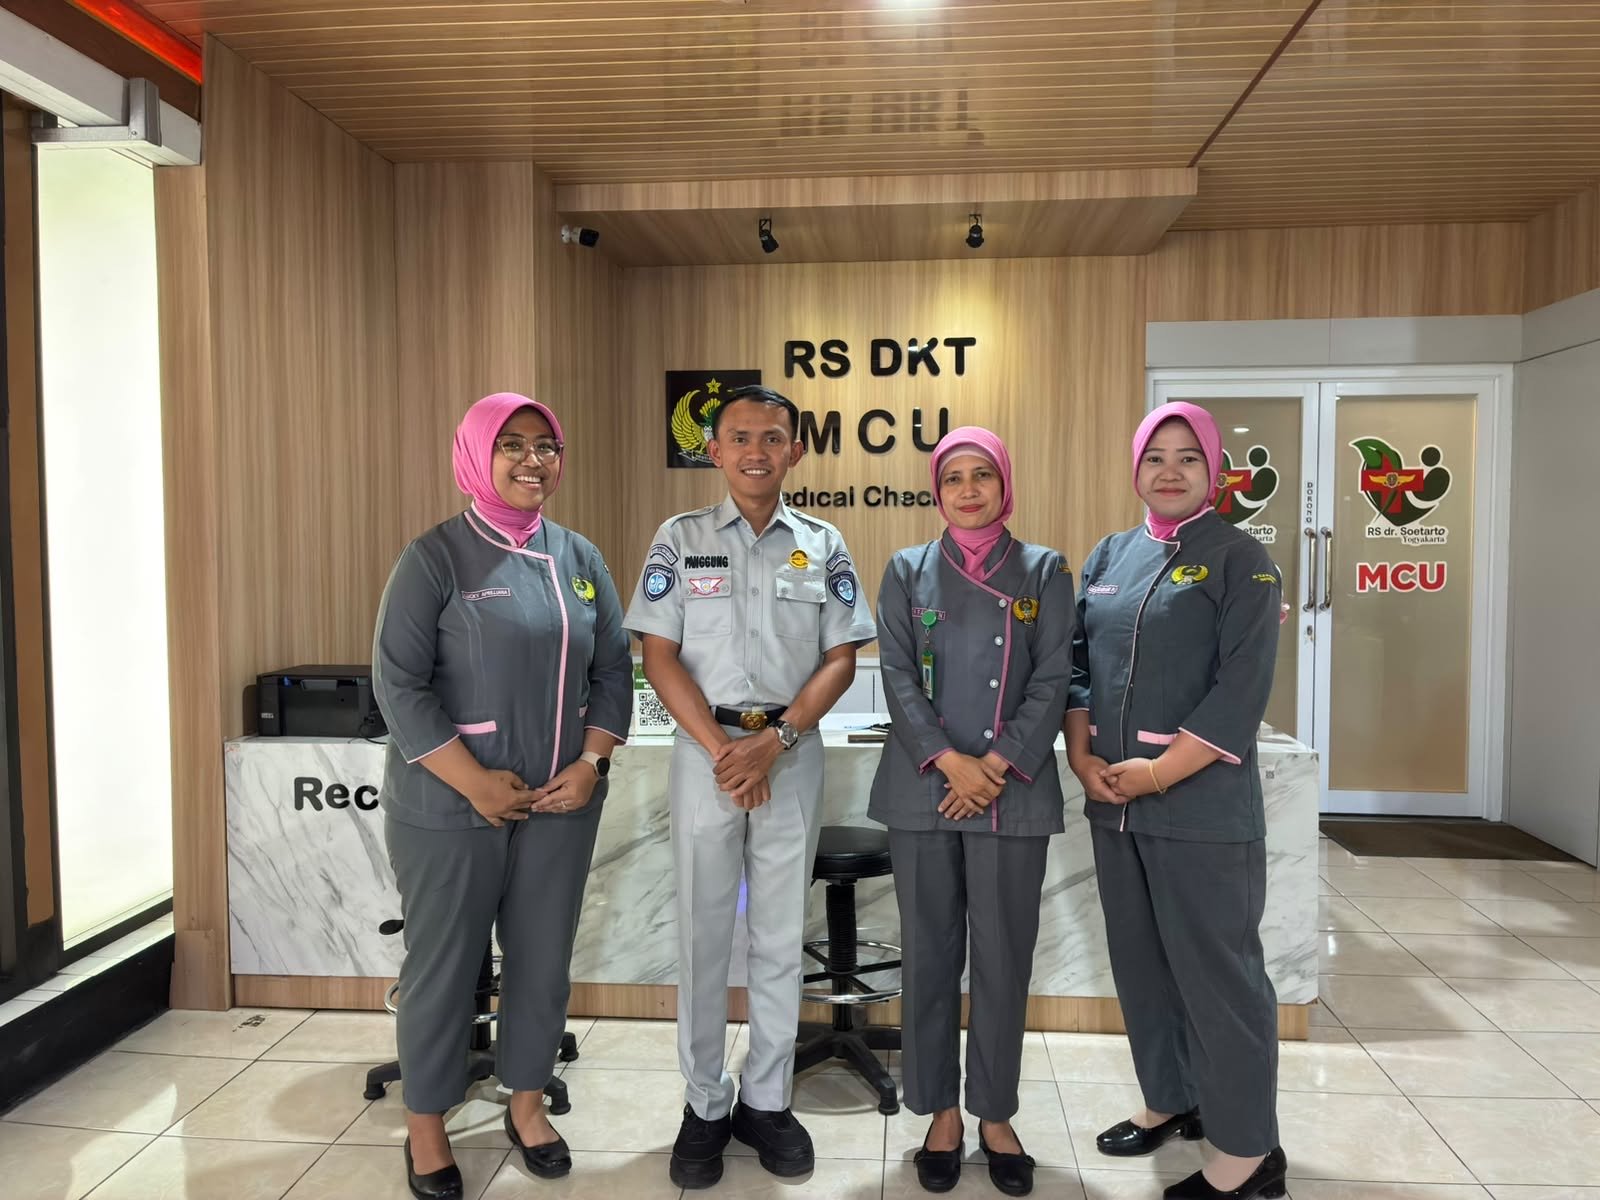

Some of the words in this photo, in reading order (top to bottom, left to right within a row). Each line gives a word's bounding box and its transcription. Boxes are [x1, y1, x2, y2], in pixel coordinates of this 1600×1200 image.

[784, 339, 851, 378] RS
[871, 337, 977, 377] DKT
[781, 486, 854, 507] edical
[1367, 527, 1382, 536] RS
[1384, 526, 1398, 536] dr.
[1400, 526, 1446, 536] Soetarto
[1403, 535, 1446, 545] Yogyakarta
[685, 556, 729, 569] PANGGUNG
[1357, 562, 1446, 592] MCU
[294, 777, 380, 811] Rec
